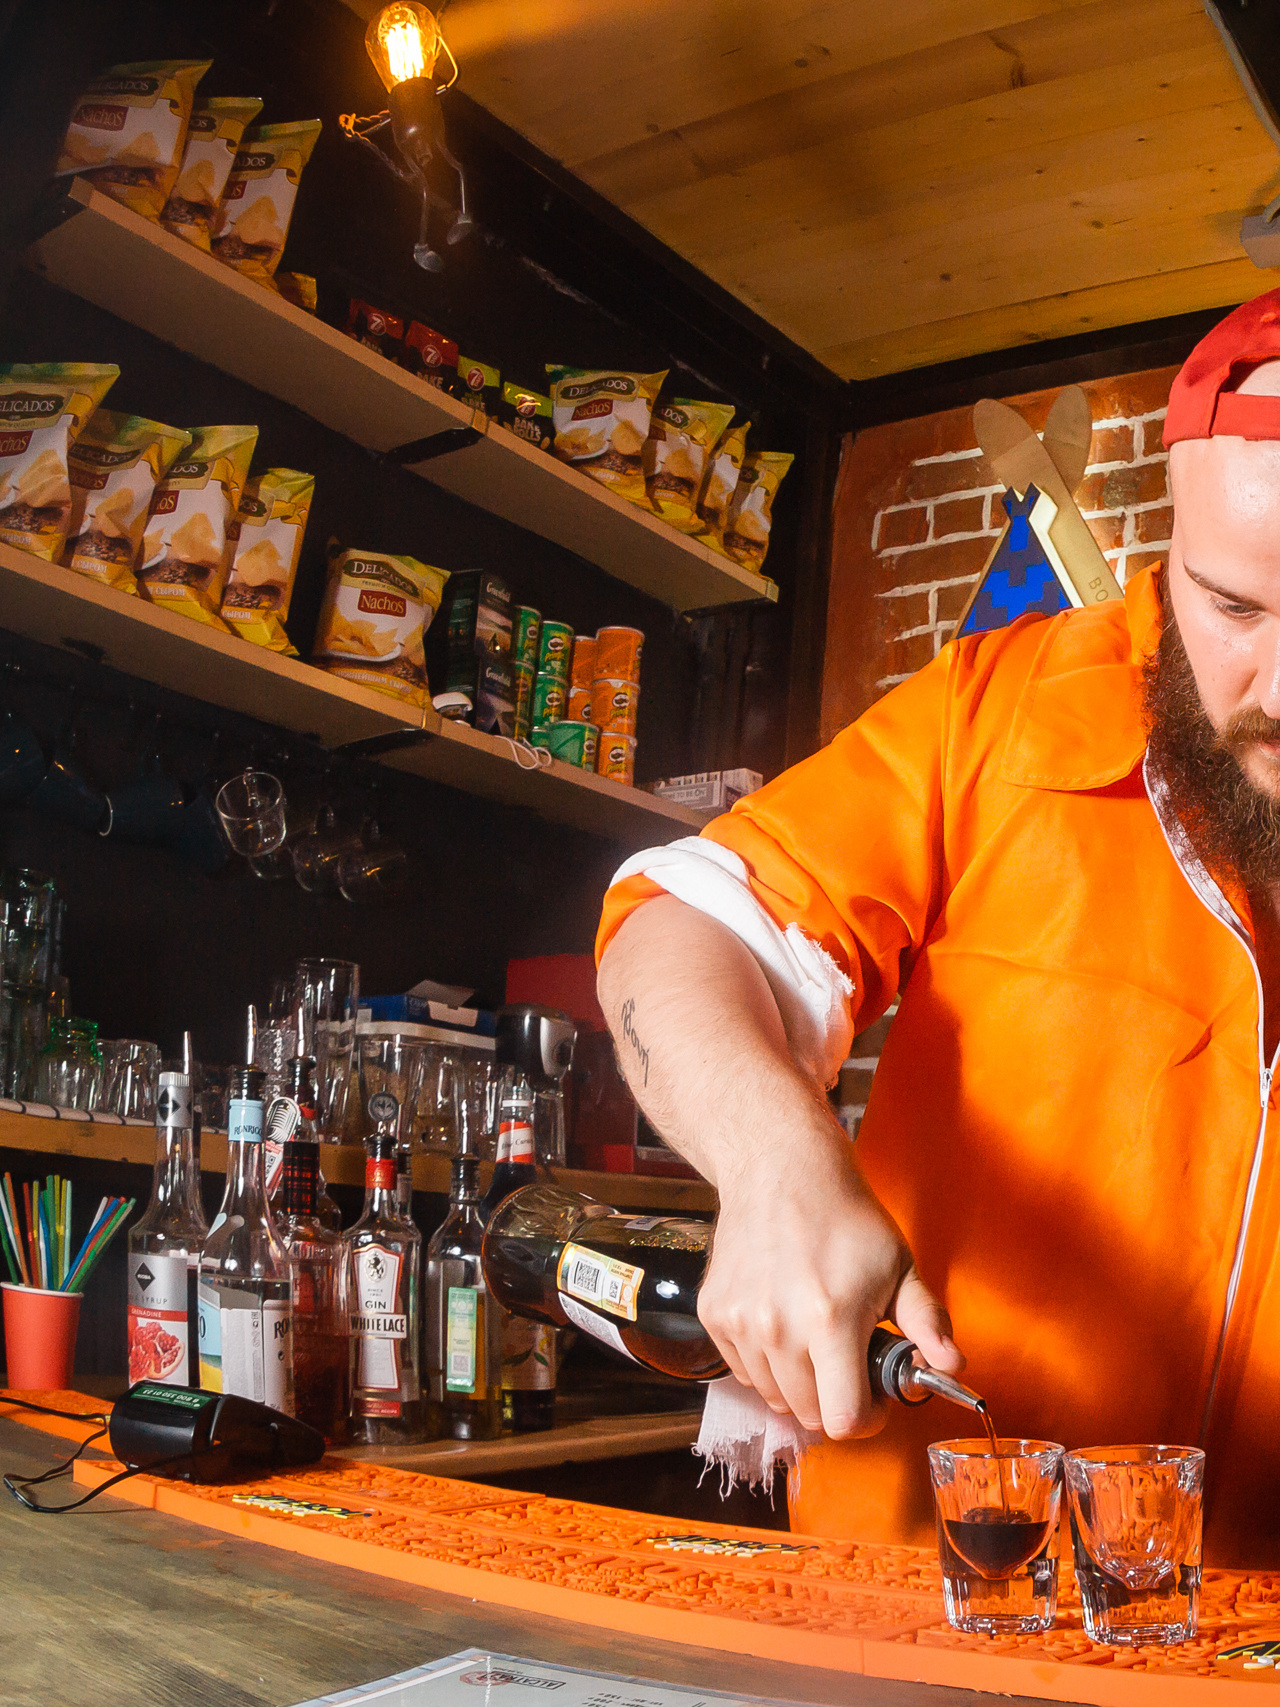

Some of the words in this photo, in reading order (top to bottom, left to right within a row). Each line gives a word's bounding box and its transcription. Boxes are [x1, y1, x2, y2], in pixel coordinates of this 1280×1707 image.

[155, 586, 186, 597] СЫРОМ
[360, 594, 405, 614] Nachos
[365, 1300, 387, 1310] GIN
[350, 1316, 382, 1332] WHITE
[383, 1317, 405, 1333] LACE
